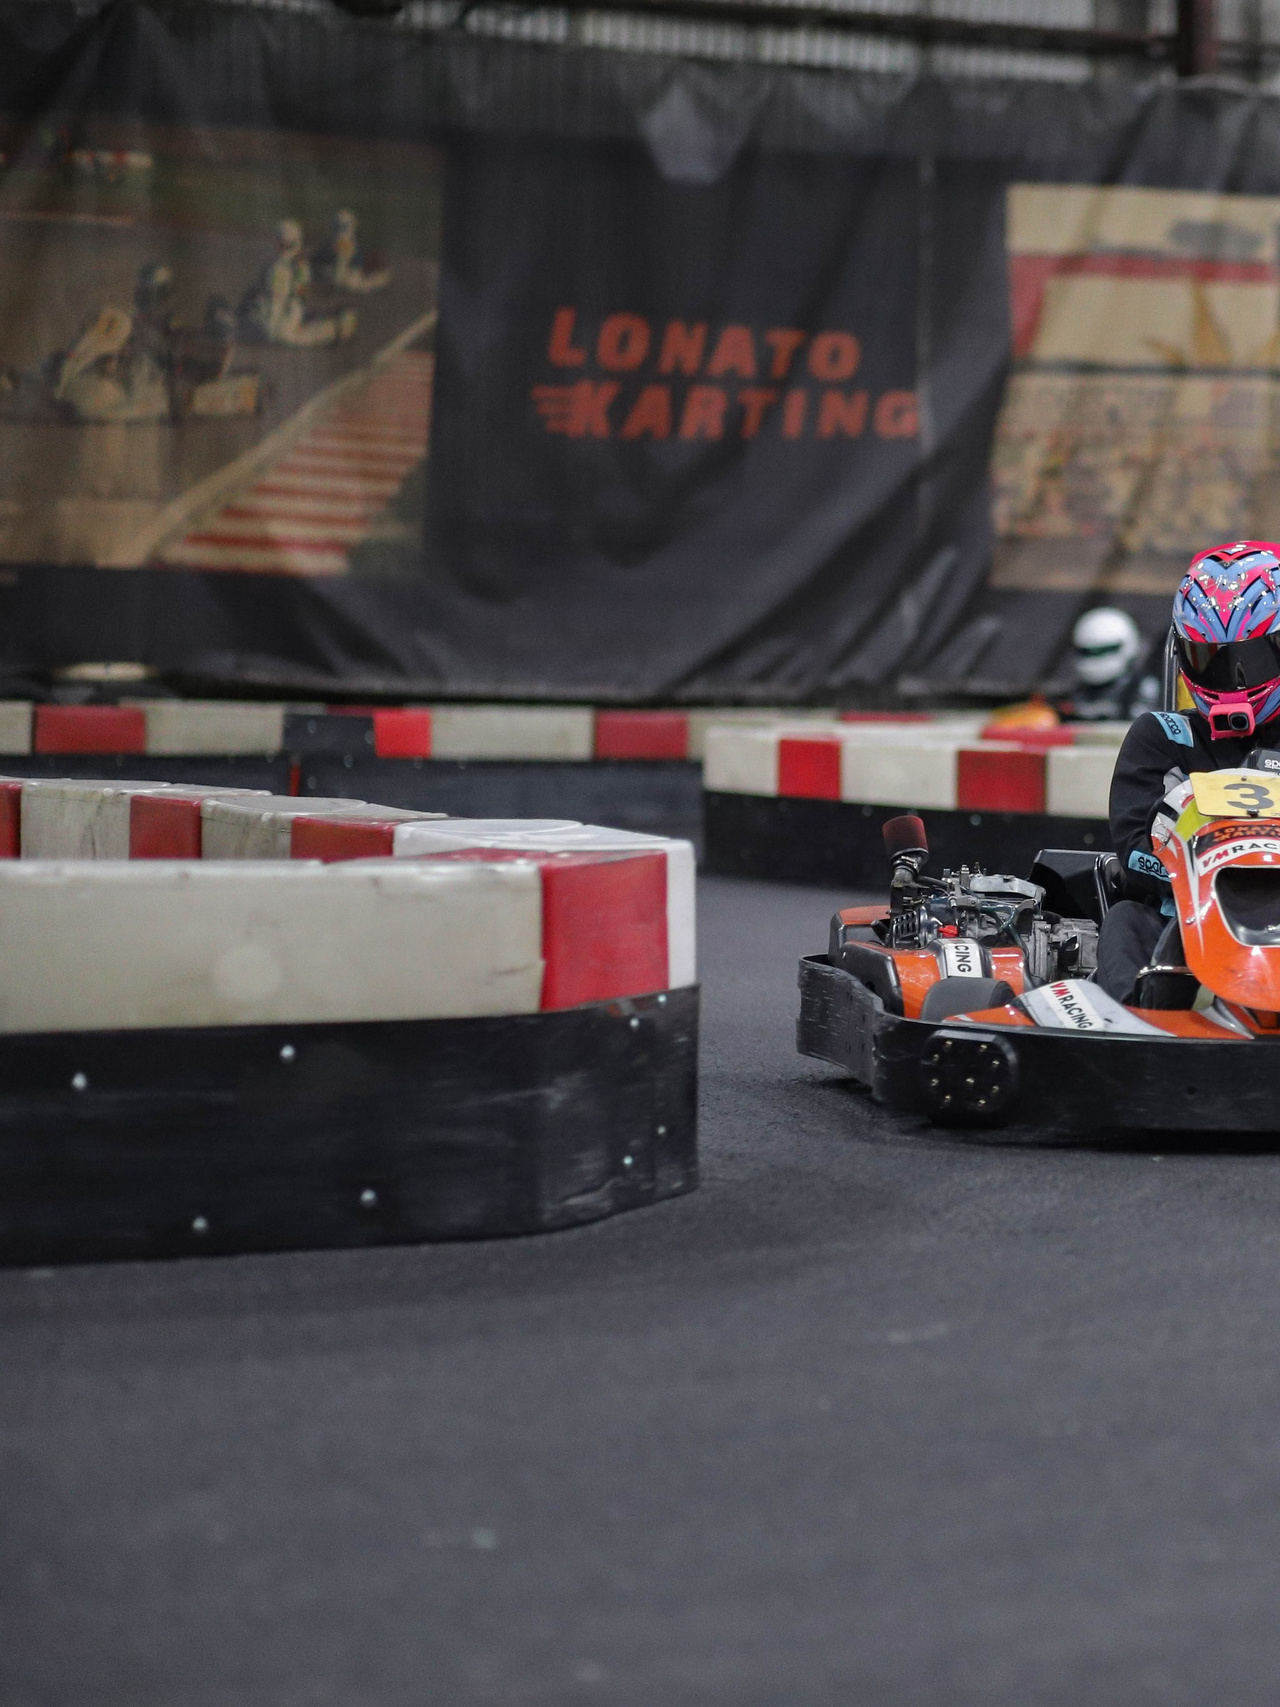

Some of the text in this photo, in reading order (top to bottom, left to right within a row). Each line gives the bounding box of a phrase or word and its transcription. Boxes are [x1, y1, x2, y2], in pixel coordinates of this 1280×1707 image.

[549, 306, 861, 381] LONATO
[531, 380, 919, 440] KARTING
[1223, 783, 1275, 810] 3
[954, 945, 972, 973] CING
